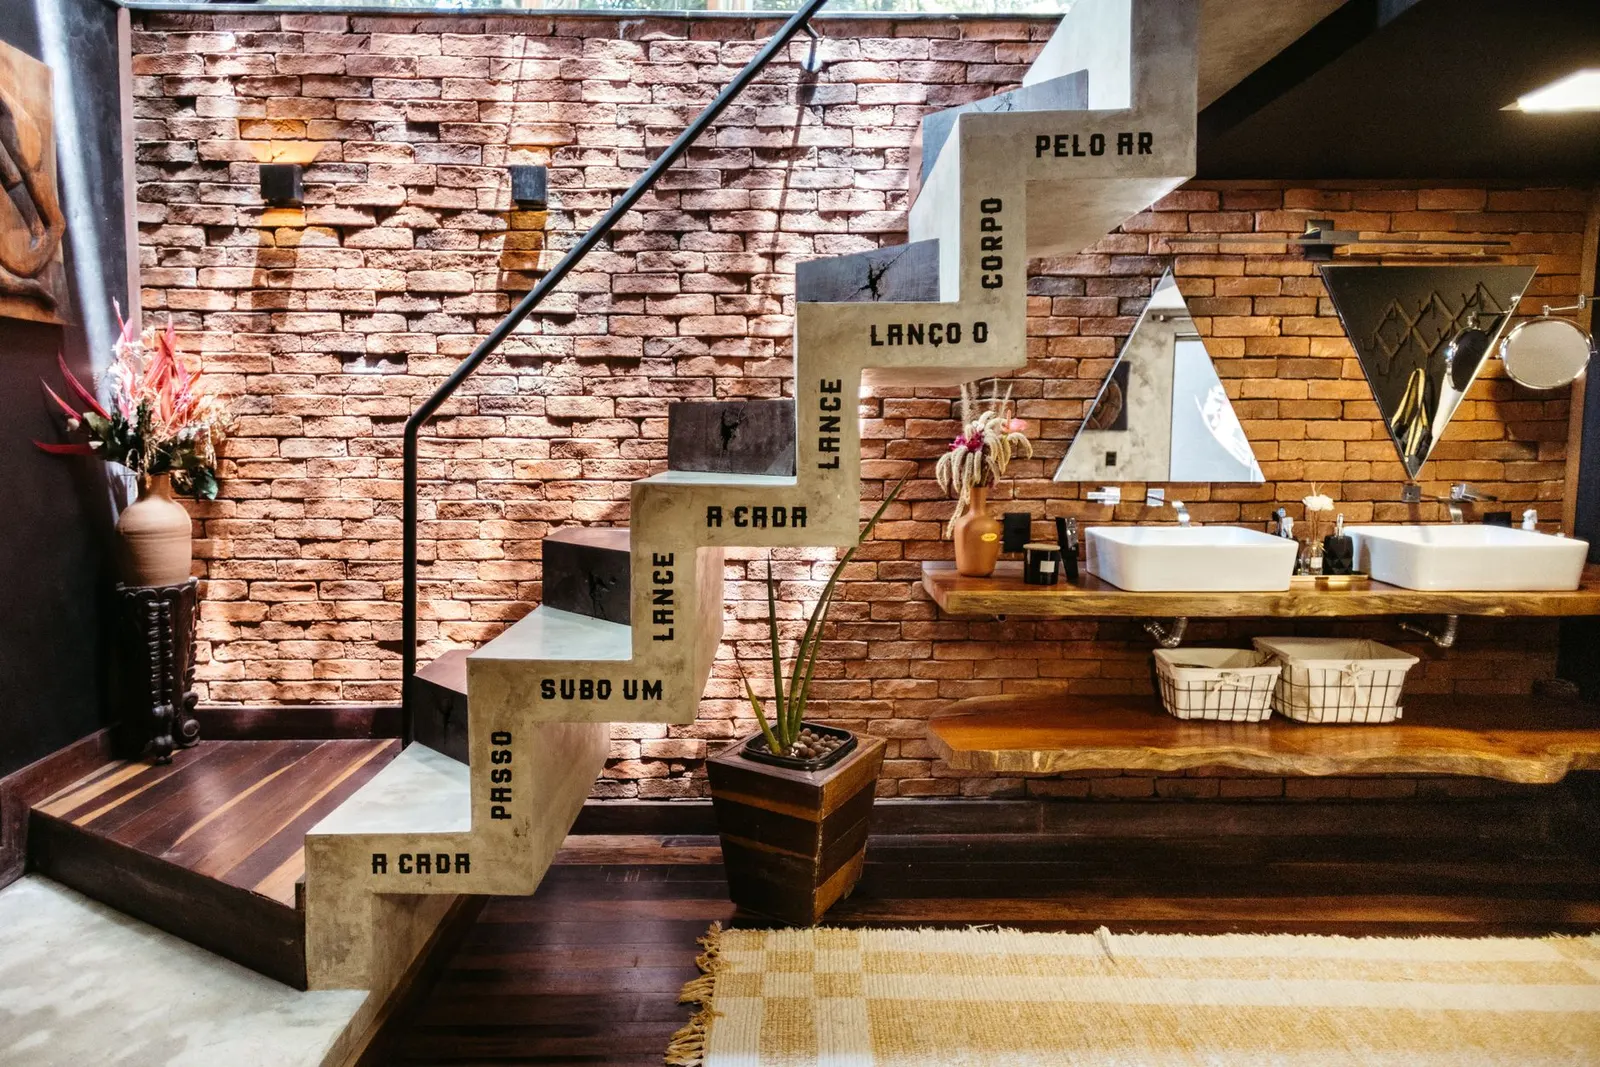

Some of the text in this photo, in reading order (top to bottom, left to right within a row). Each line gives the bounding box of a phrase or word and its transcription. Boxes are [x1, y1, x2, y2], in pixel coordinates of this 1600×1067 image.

[1034, 131, 1154, 159] PELO AR
[980, 197, 1004, 290] CORPO
[869, 321, 989, 348] LANÇO O
[817, 378, 842, 470] LANCE
[706, 505, 808, 528] A CADA
[652, 552, 675, 642] LANCE
[540, 678, 663, 701] SUBO UM
[490, 730, 513, 821] PASSO
[371, 852, 472, 875] A CADA
